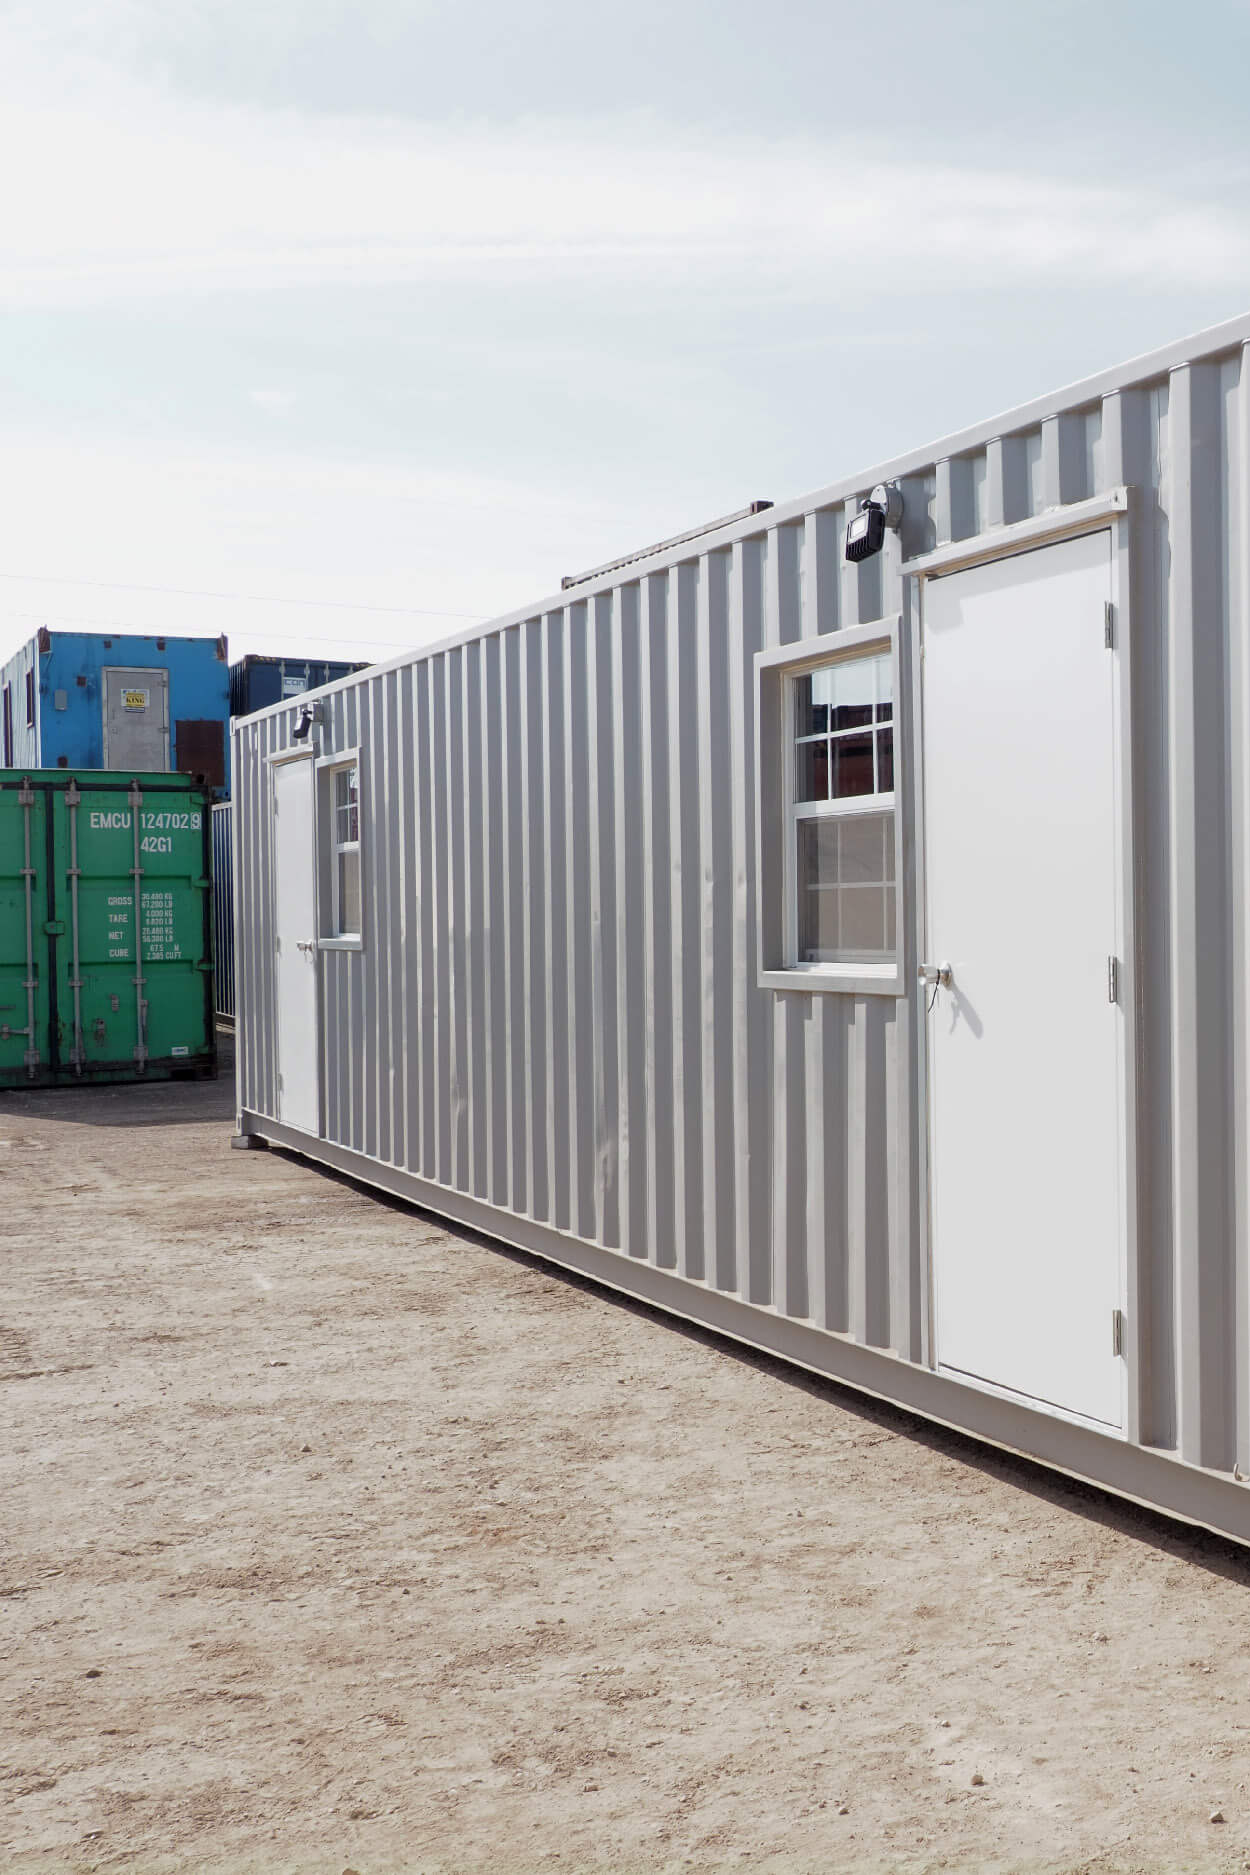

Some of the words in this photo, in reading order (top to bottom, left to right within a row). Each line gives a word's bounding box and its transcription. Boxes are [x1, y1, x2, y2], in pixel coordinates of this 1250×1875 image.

[90, 812, 131, 829] EMCU
[141, 836, 172, 853] 42G1
[108, 897, 132, 905] GROSS
[109, 914, 128, 923] TARE
[109, 931, 123, 940] NET
[109, 948, 129, 957] CUBE
